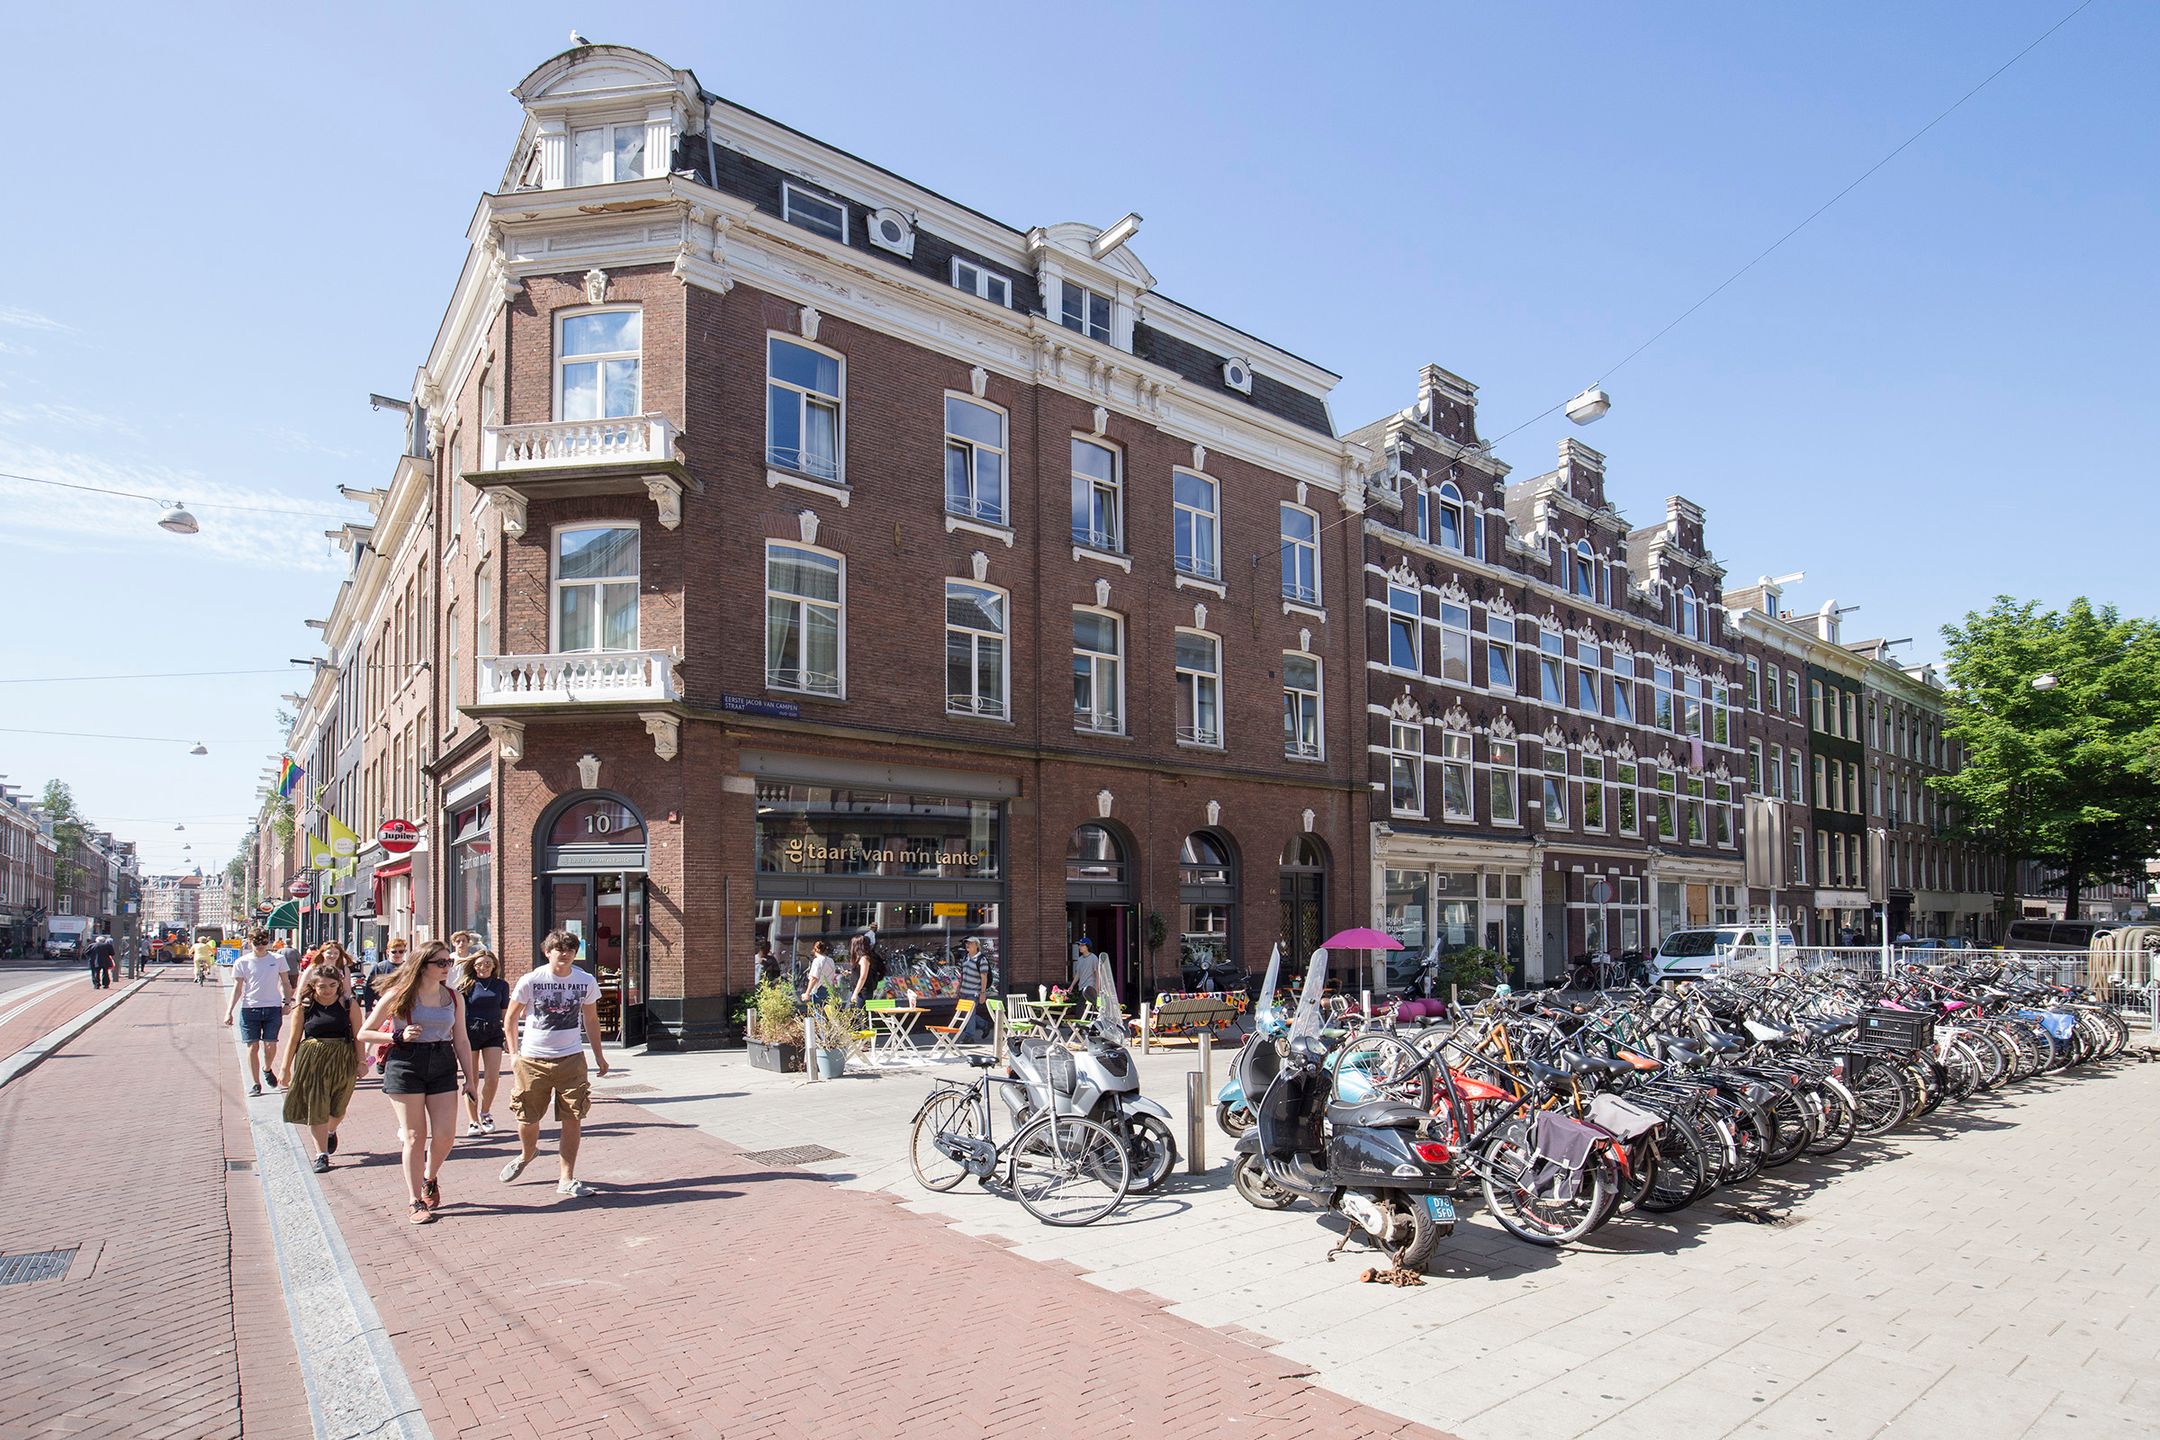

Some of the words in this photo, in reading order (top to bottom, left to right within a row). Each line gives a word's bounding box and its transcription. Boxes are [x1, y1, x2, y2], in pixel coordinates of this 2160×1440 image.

[724, 696, 744, 704] EERSTE
[745, 698, 762, 706] JACOB
[775, 702, 798, 711] CAMPEN
[584, 815, 611, 834] 10
[383, 832, 416, 841] Jupiler
[785, 838, 804, 863] de
[808, 843, 857, 861] taart
[862, 849, 894, 862] van
[899, 847, 931, 863] m'n
[935, 850, 979, 866] tante
[533, 982, 566, 991] POLITICAL
[567, 983, 588, 991] PARTY
